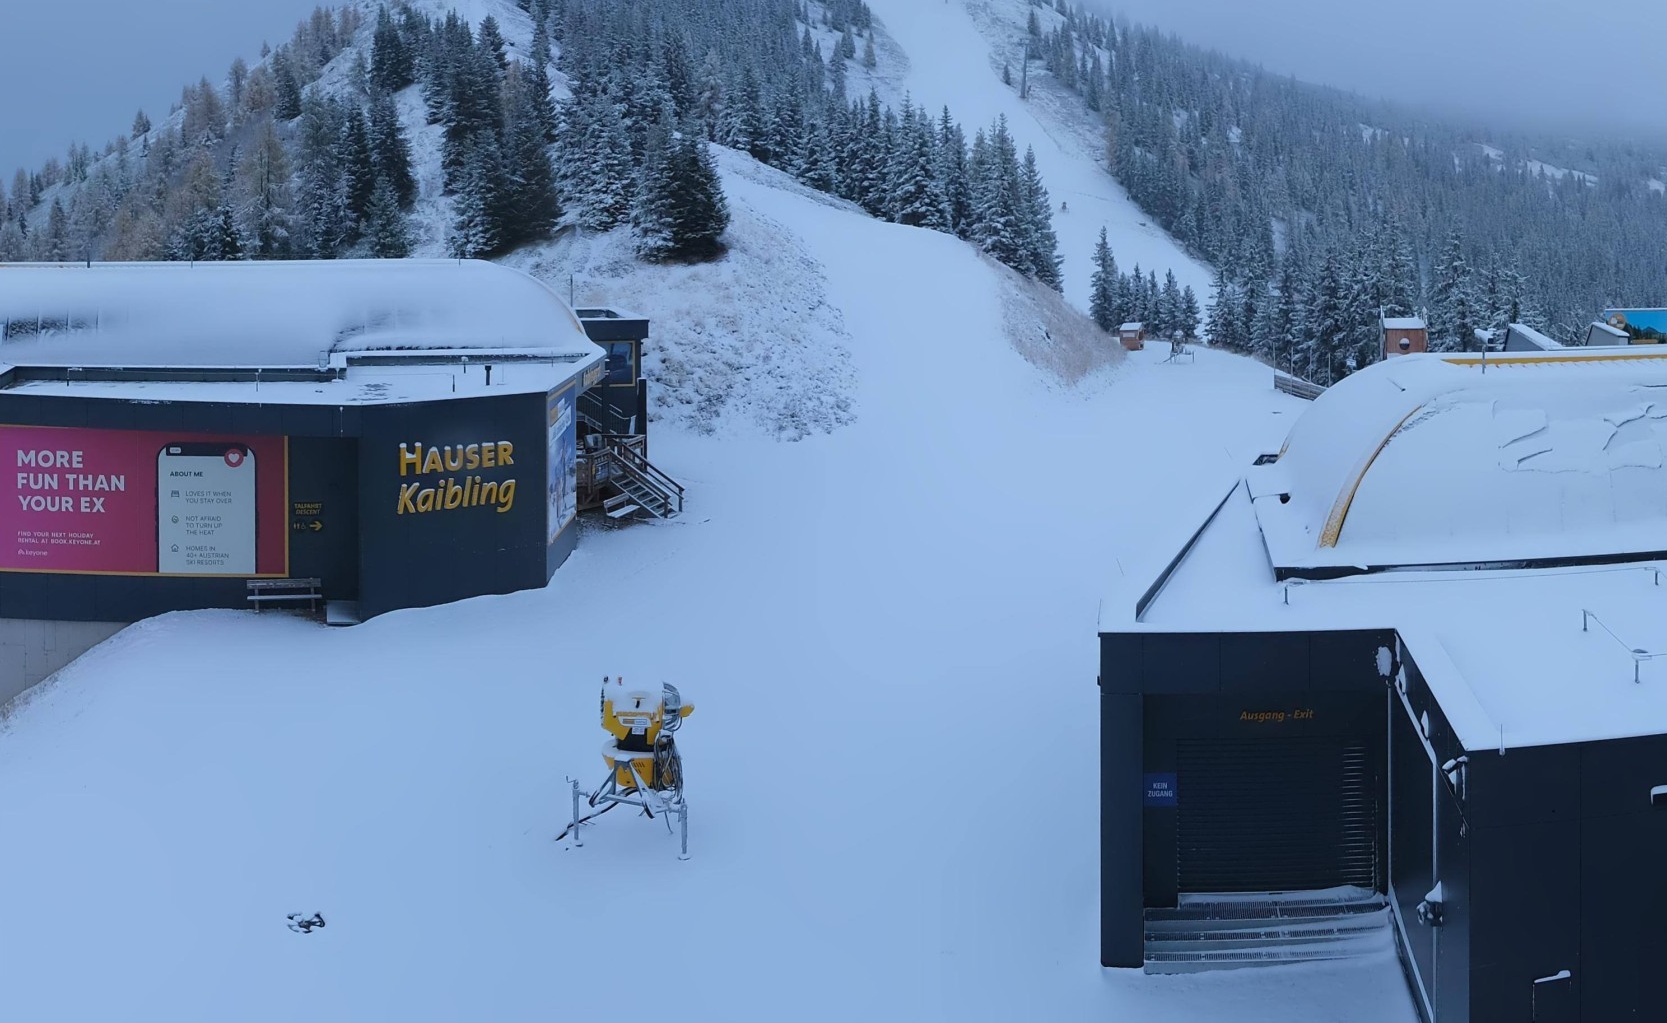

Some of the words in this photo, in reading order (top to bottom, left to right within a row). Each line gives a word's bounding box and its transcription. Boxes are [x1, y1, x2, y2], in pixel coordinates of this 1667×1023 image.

[18, 450, 83, 468] MORE
[399, 441, 514, 476] HAUSER
[18, 473, 58, 489] FUN
[66, 474, 125, 491] THAN
[397, 476, 516, 514] Kaibling
[18, 496, 73, 512] YOUR
[81, 497, 105, 513] EX
[1240, 710, 1285, 722] Ausgang
[1294, 709, 1314, 719] Exit
